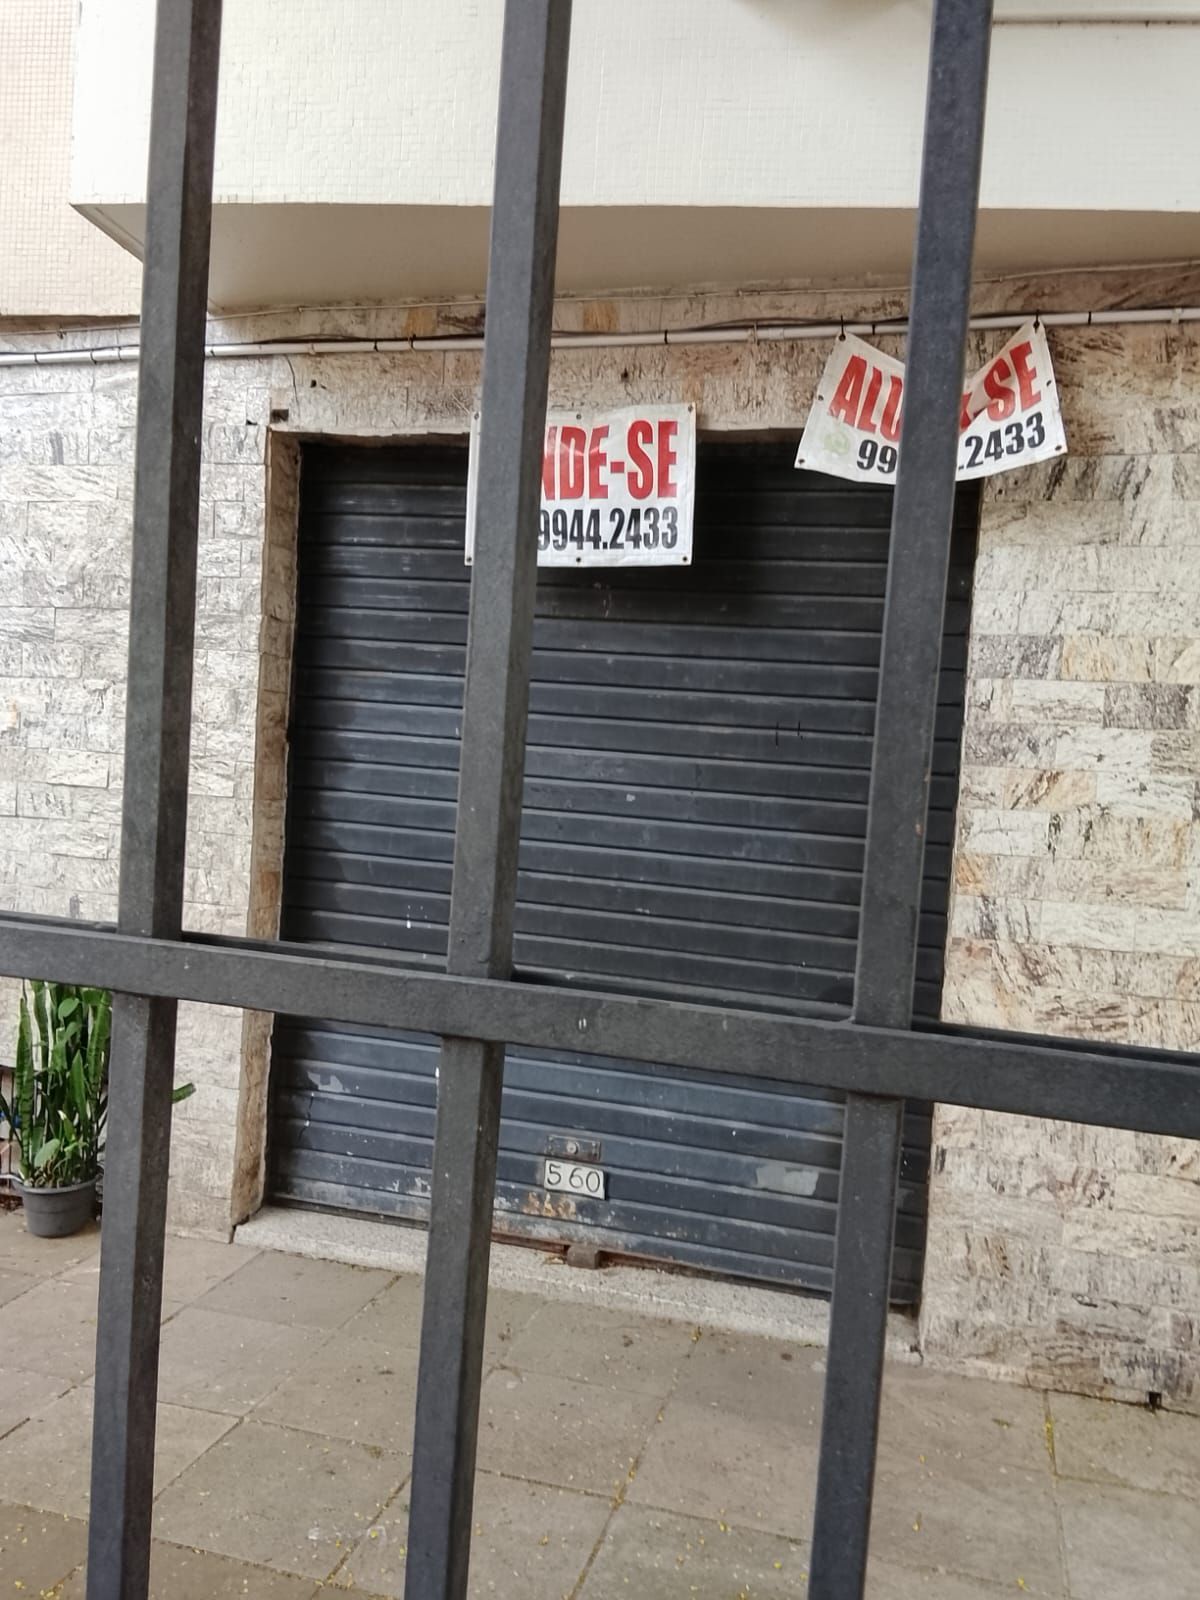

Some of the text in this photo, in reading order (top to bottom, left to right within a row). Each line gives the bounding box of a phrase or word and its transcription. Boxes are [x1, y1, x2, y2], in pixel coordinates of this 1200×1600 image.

[828, 341, 1042, 442] ALUSE
[542, 420, 678, 501] NDE-SE
[857, 411, 1046, 474] 99.2433
[547, 1162, 601, 1193] 560
